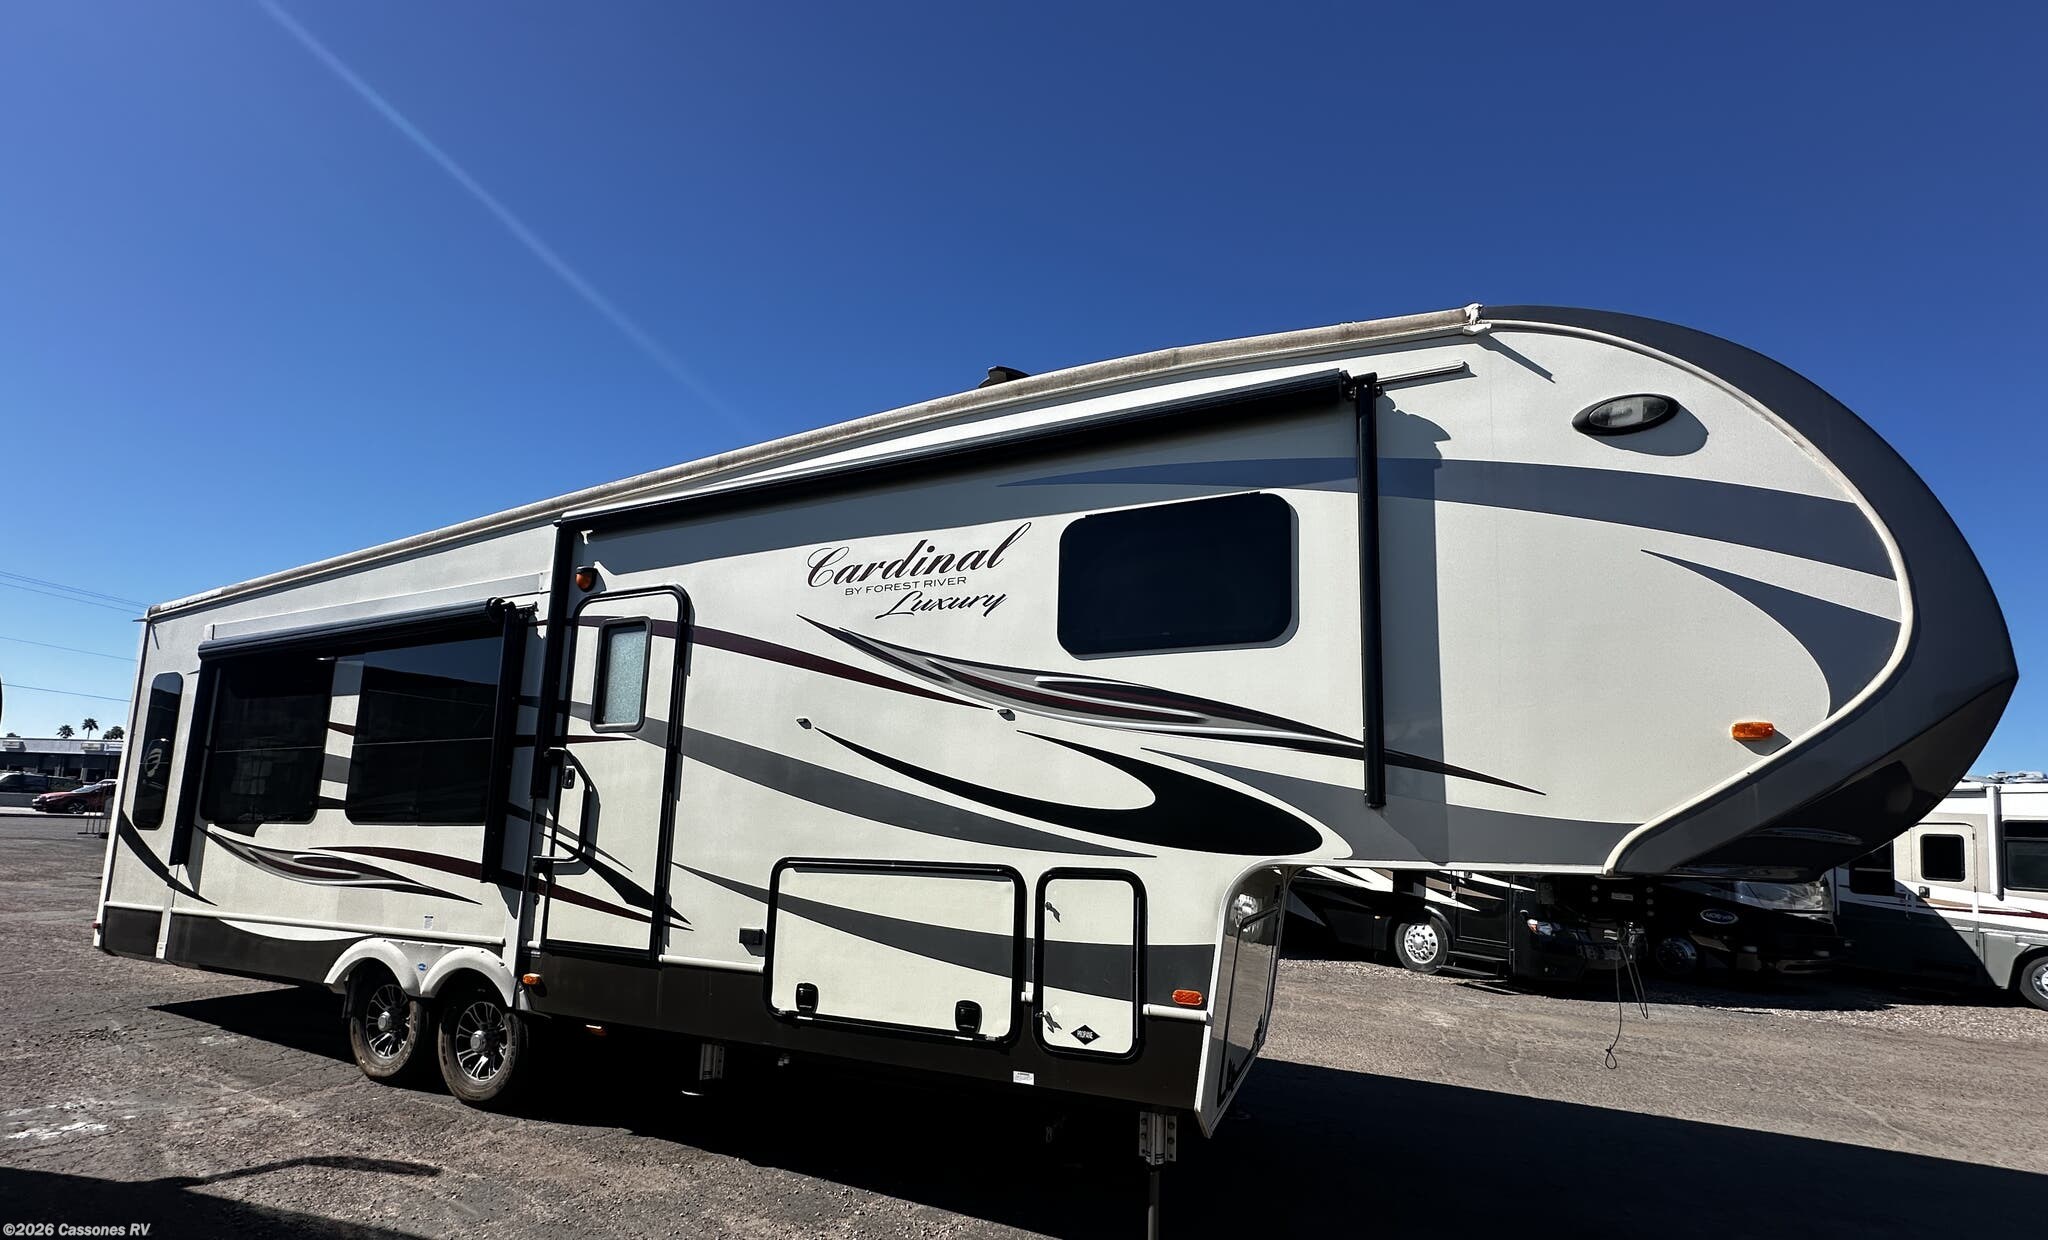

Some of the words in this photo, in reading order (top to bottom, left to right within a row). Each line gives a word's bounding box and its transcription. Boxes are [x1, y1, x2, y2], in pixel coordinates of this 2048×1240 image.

[807, 521, 1032, 588] Cardinal
[845, 587, 863, 596] BY
[865, 580, 921, 594] FOREST
[923, 575, 967, 589] RIVER
[874, 590, 1007, 620] Luxury
